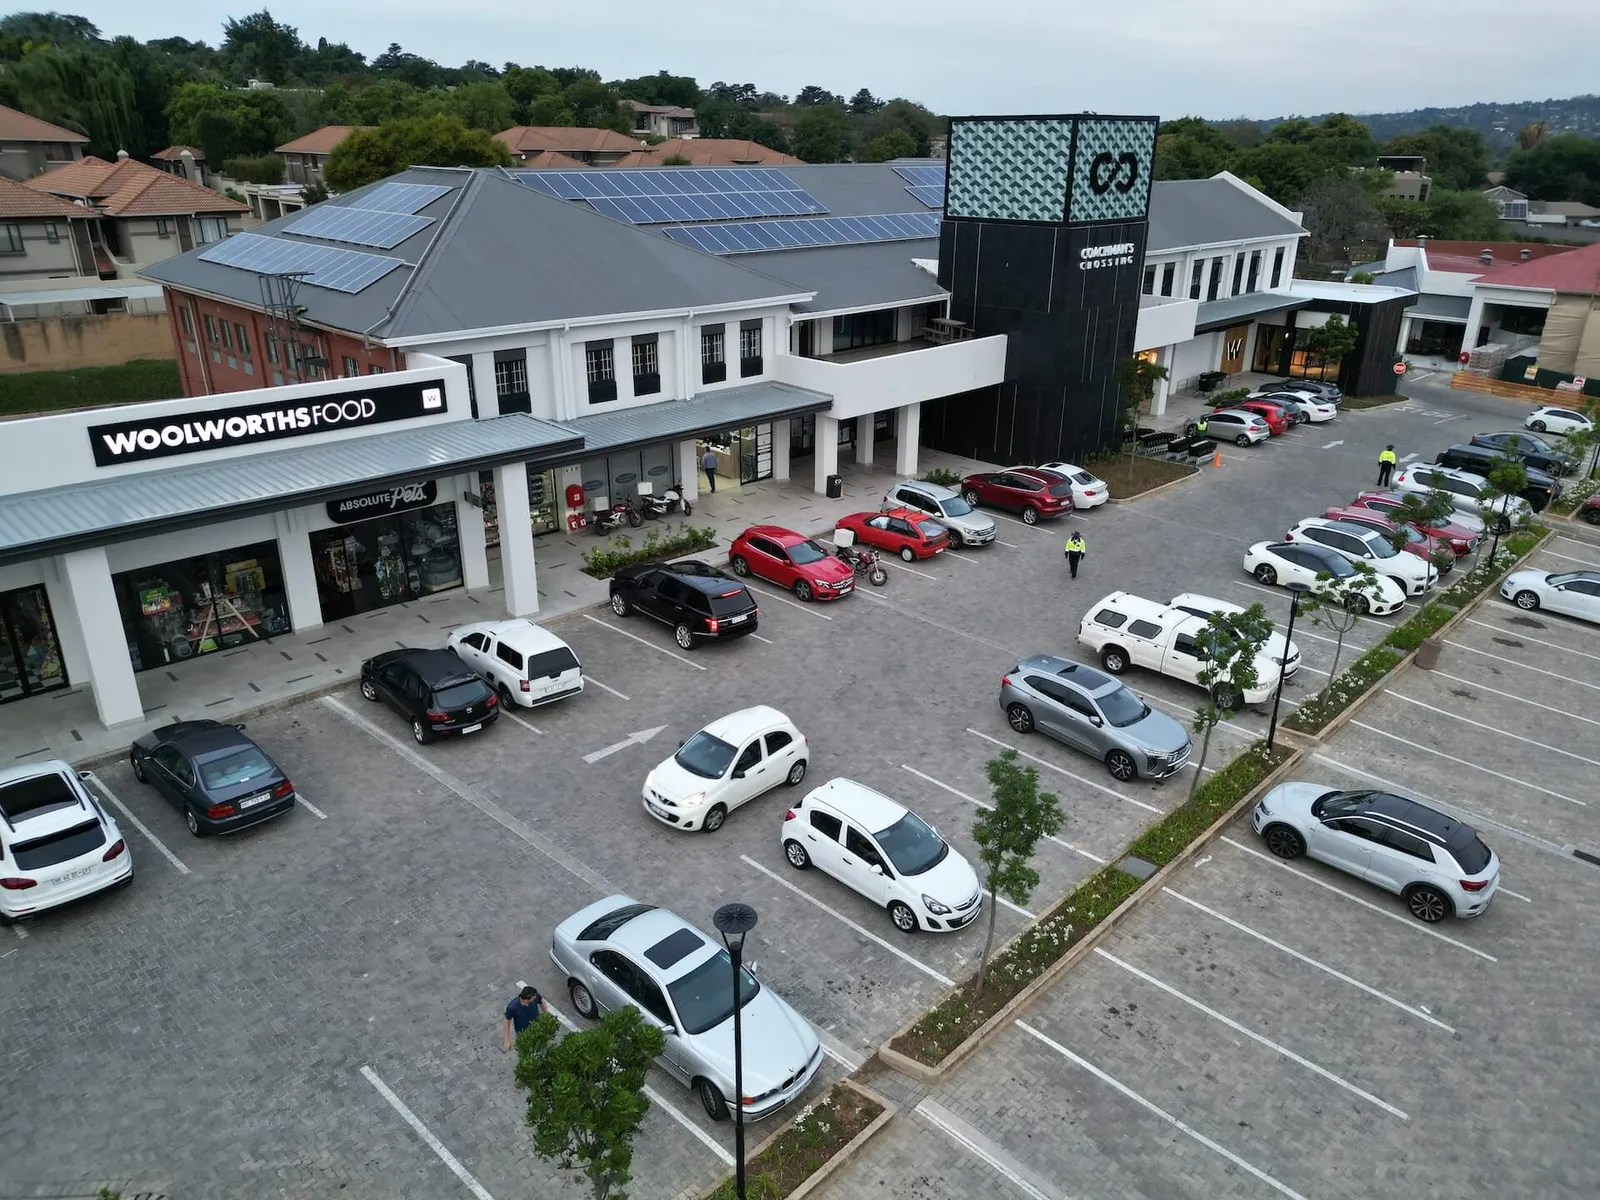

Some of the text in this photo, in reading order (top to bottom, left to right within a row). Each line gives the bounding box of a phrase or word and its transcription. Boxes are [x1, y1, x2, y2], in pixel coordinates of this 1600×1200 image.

[1080, 243, 1135, 259] COACHMAN'S
[1079, 256, 1133, 270] CROSSING
[339, 492, 391, 512] ABSOLUTE
